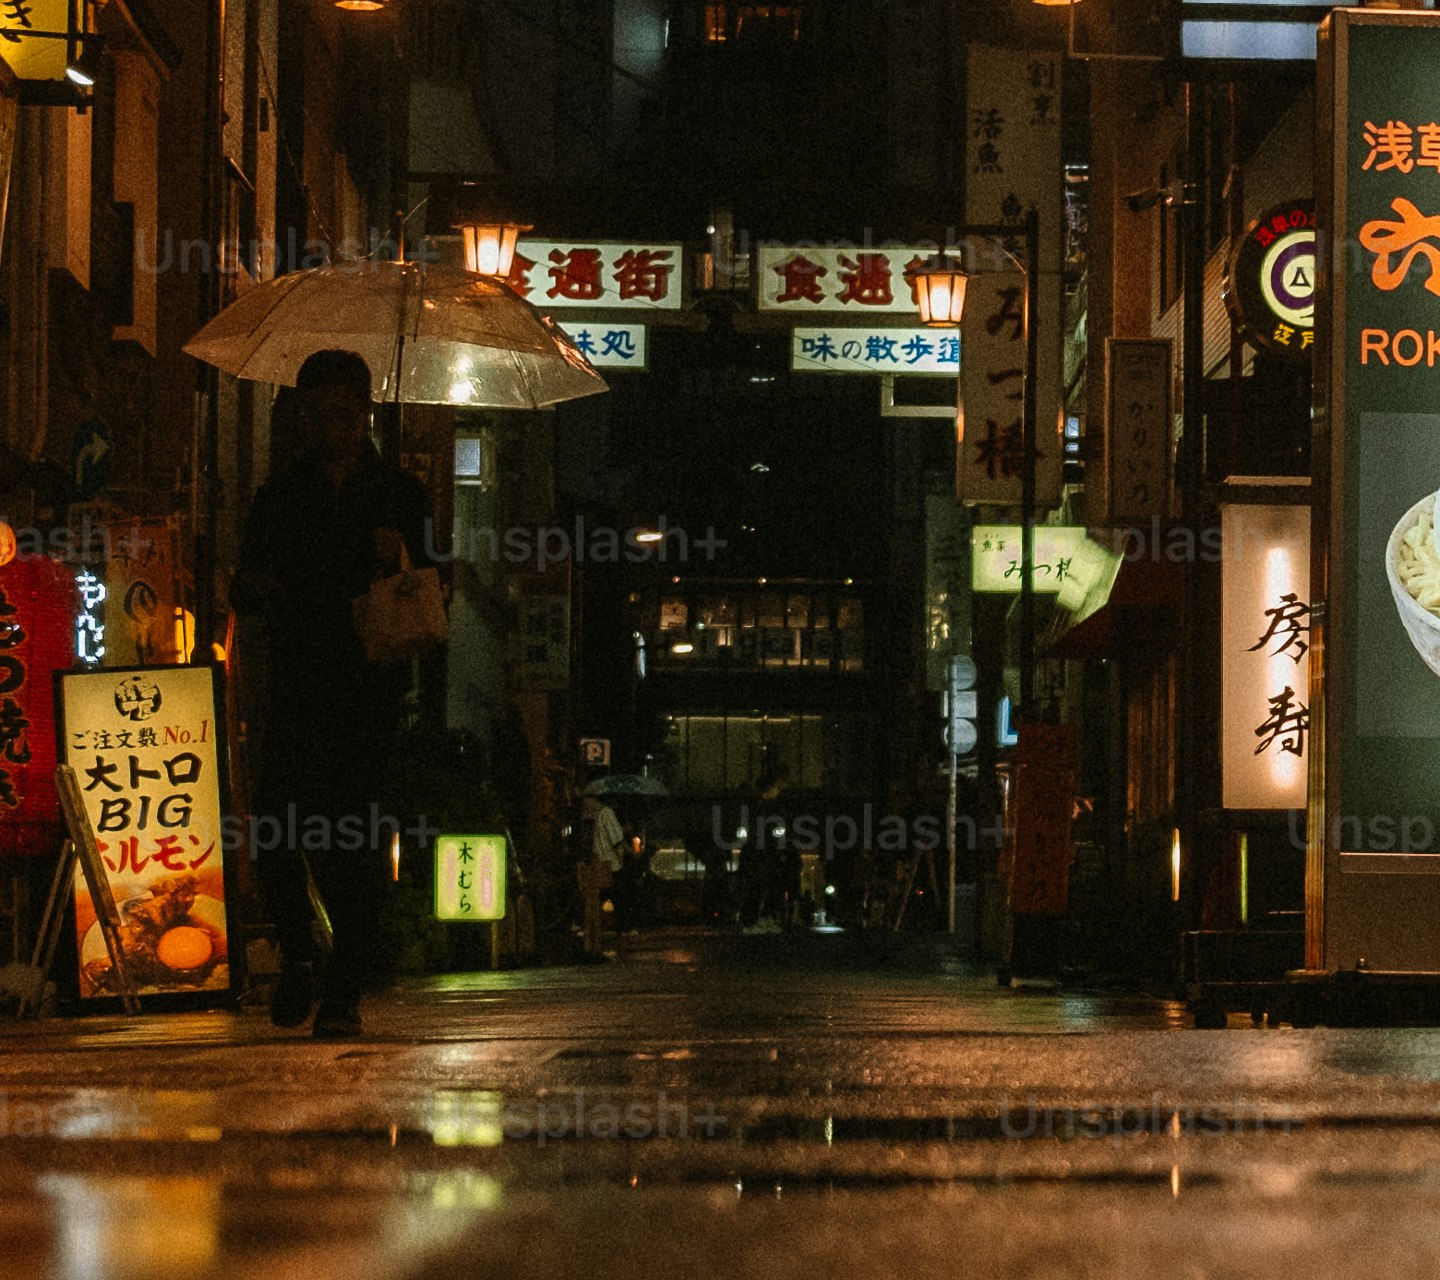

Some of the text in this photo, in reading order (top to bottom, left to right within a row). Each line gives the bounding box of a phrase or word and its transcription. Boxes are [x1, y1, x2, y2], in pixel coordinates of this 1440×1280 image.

[71, 719, 210, 751] ご注文数 No.1
[83, 752, 204, 793] 大トロ
[96, 792, 194, 834] BIG
[458, 841, 475, 913] 木むら
